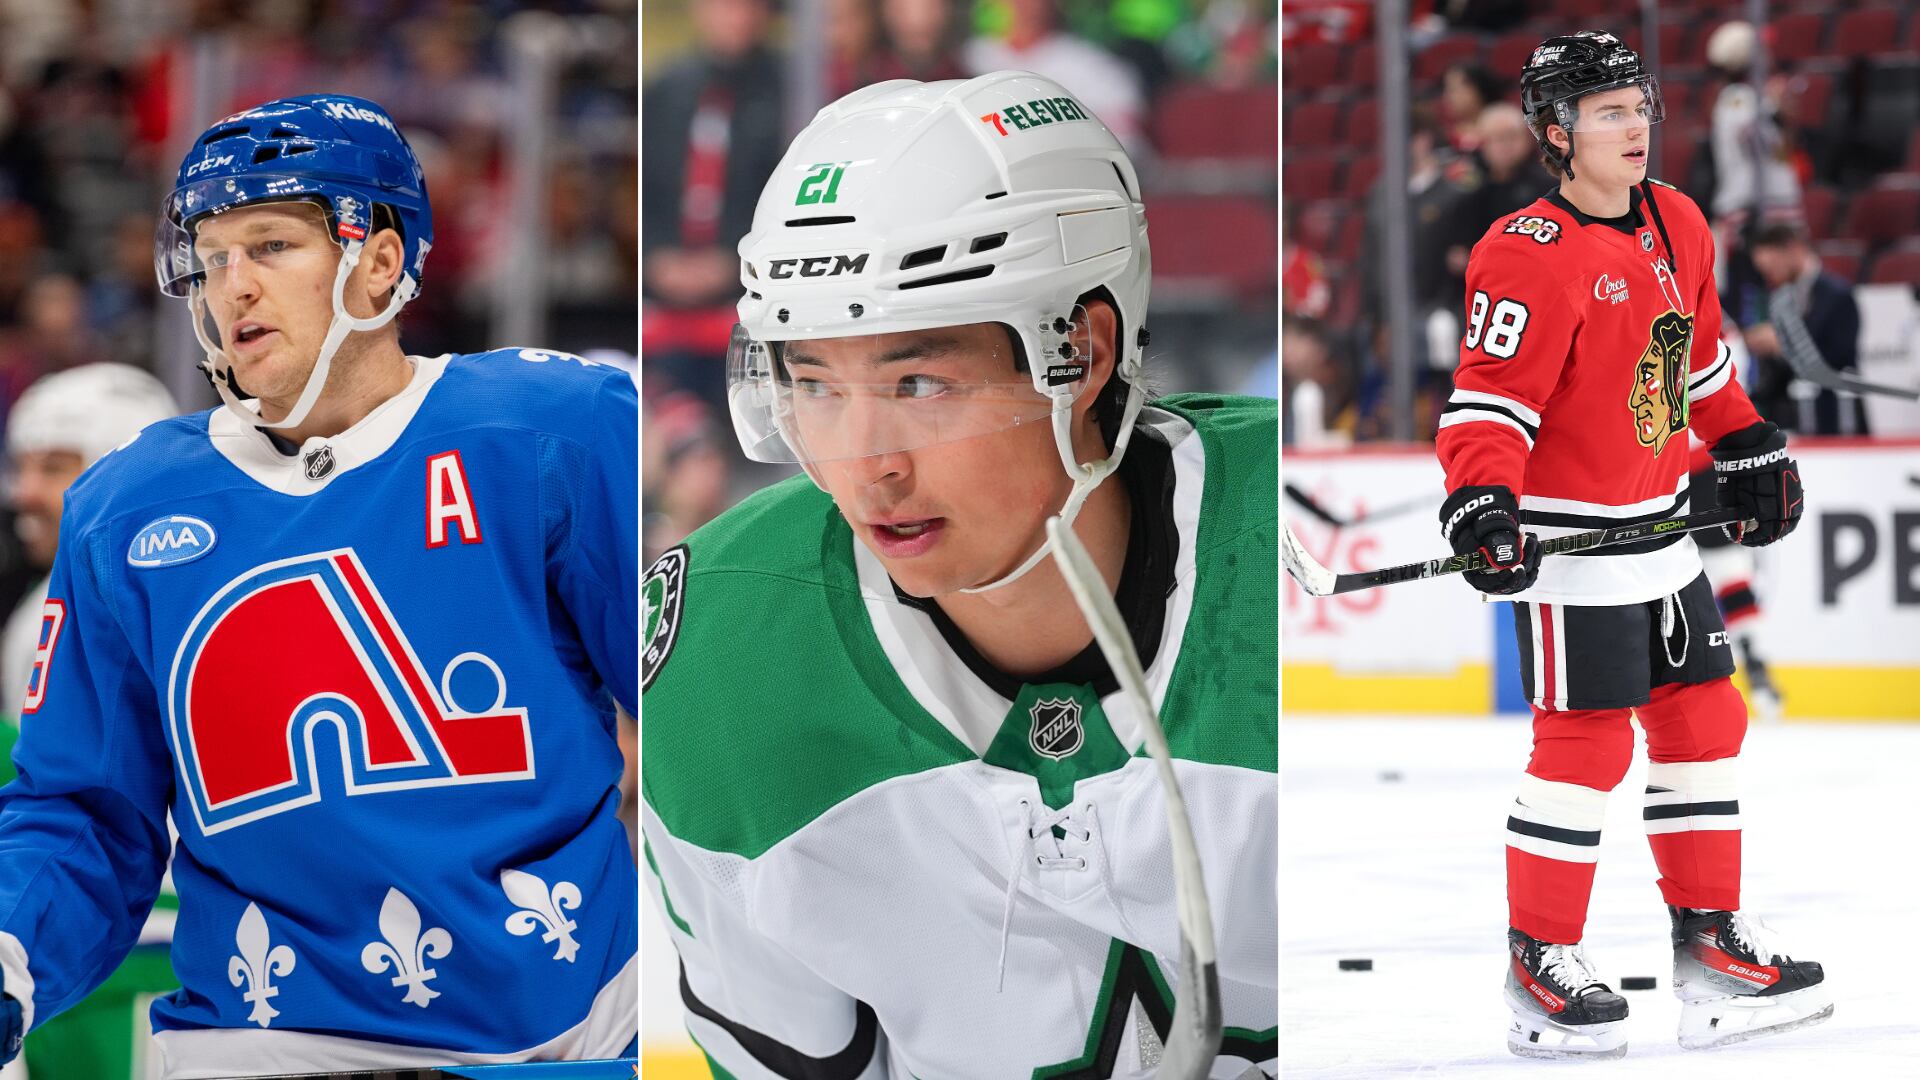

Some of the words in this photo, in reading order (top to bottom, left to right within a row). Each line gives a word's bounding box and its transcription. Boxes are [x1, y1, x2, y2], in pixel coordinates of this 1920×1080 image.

[1543, 46, 1567, 54] BELLE
[1608, 56, 1635, 66] CCM
[980, 98, 1089, 136] 7-ELEVEN
[187, 155, 234, 177] CCM
[795, 161, 853, 206] 21
[769, 253, 870, 280] CCM
[1594, 274, 1626, 300] Circa
[1466, 290, 1530, 360] 98
[312, 453, 329, 475] NHL
[425, 449, 483, 550] A
[140, 526, 199, 557] IMA
[1615, 529, 1640, 539] ETS
[1042, 713, 1073, 747] NHL
